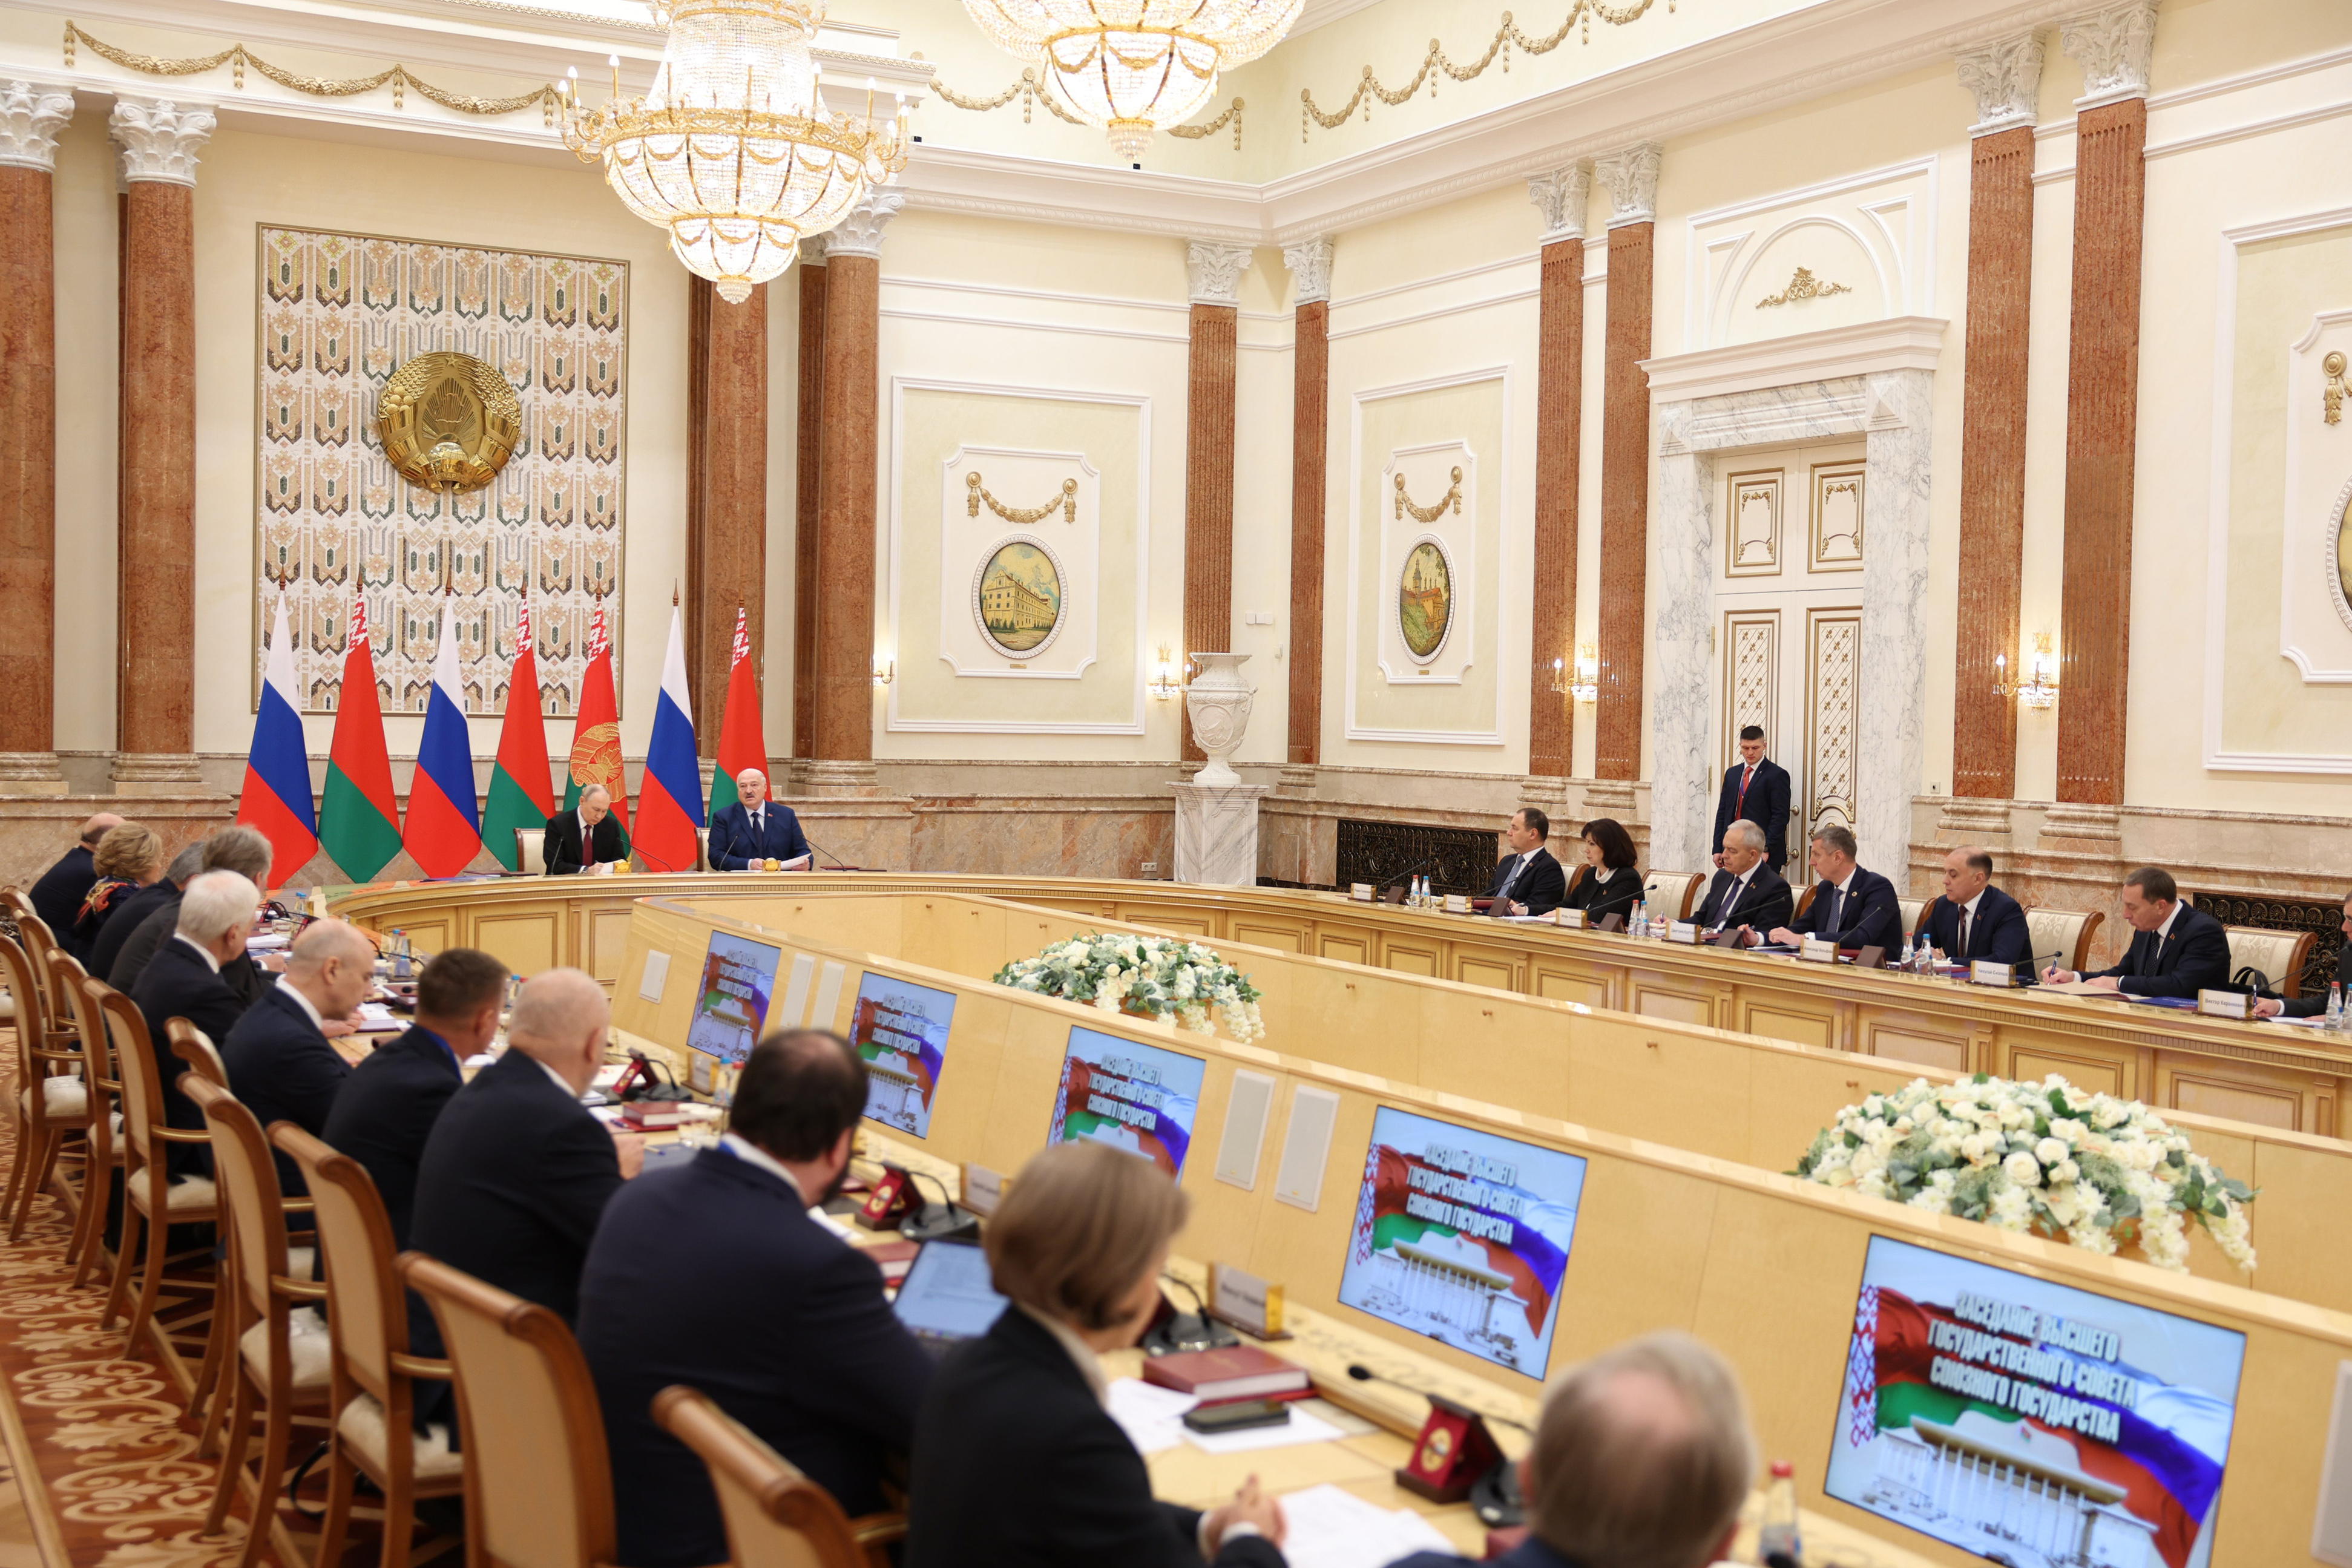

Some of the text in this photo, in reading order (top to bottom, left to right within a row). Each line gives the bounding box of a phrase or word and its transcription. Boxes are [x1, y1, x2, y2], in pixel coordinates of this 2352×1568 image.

[1927, 1319, 2137, 1408] ГОСУДАРСТВЕННОГО СОВЕТА
[1954, 1293, 2119, 1362] ЗАСЕДАНИЕ ВЫСШЕГО
[1930, 1356, 2120, 1444] СОЮЗНОГО ГОСУДАРСТВА
